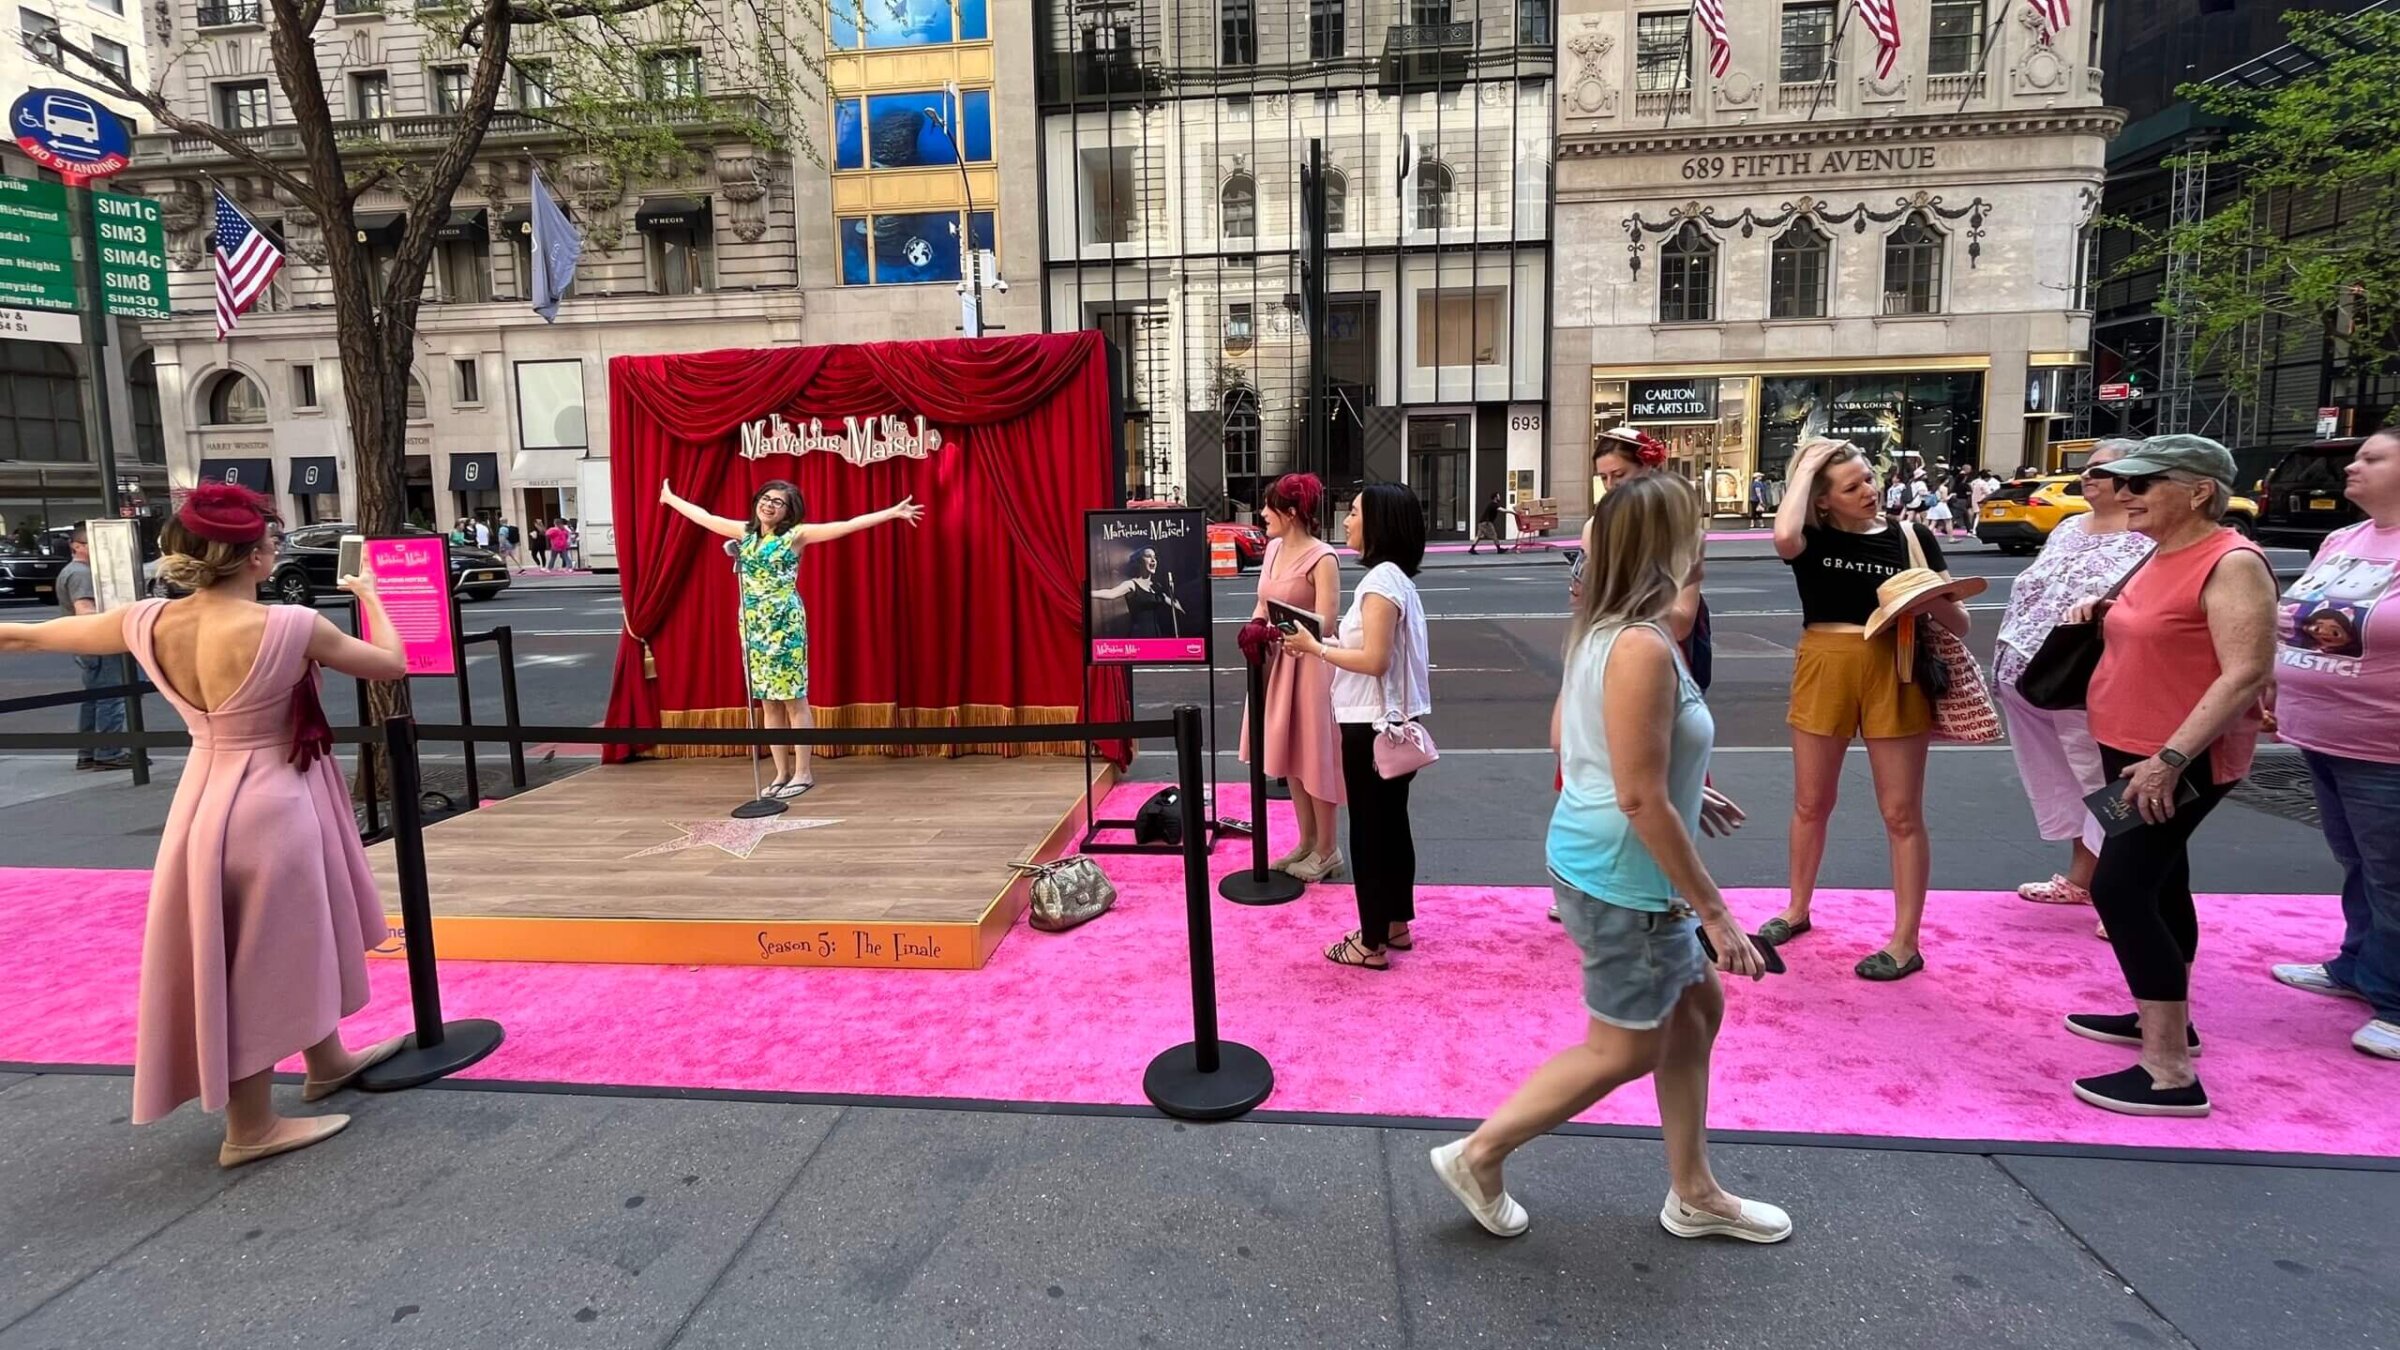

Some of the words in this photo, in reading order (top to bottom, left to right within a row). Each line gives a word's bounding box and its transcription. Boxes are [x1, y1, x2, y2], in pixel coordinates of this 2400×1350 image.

[28, 143, 49, 160] NO
[54, 158, 121, 174] STANDING
[1681, 157, 1725, 180] 689
[1731, 153, 1812, 177] FIFTH
[1819, 147, 1936, 174] AVENUE
[100, 222, 147, 243] SIM3
[16, 258, 61, 272] Heights
[105, 272, 151, 291] SIM8
[36, 297, 73, 309] Harbor
[107, 293, 159, 307] SIM30
[16, 323, 28, 332] St
[1645, 388, 1696, 401] CARLTON
[1632, 404, 1655, 415] FINE
[1656, 403, 1684, 414] ARTS
[1685, 402, 1707, 413] LTD.
[770, 414, 790, 432] The
[1511, 416, 1541, 431] 693
[206, 442, 232, 450] HARRY
[234, 441, 269, 449] WINSTON
[740, 418, 842, 460] Marvelous
[844, 415, 929, 465] Maisel
[1103, 523, 1148, 540] Marvelous
[1150, 519, 1185, 541] Maisel
[757, 931, 812, 960] Season
[818, 931, 836, 958] 5:
[852, 930, 882, 959] The
[893, 932, 942, 962] Finale
